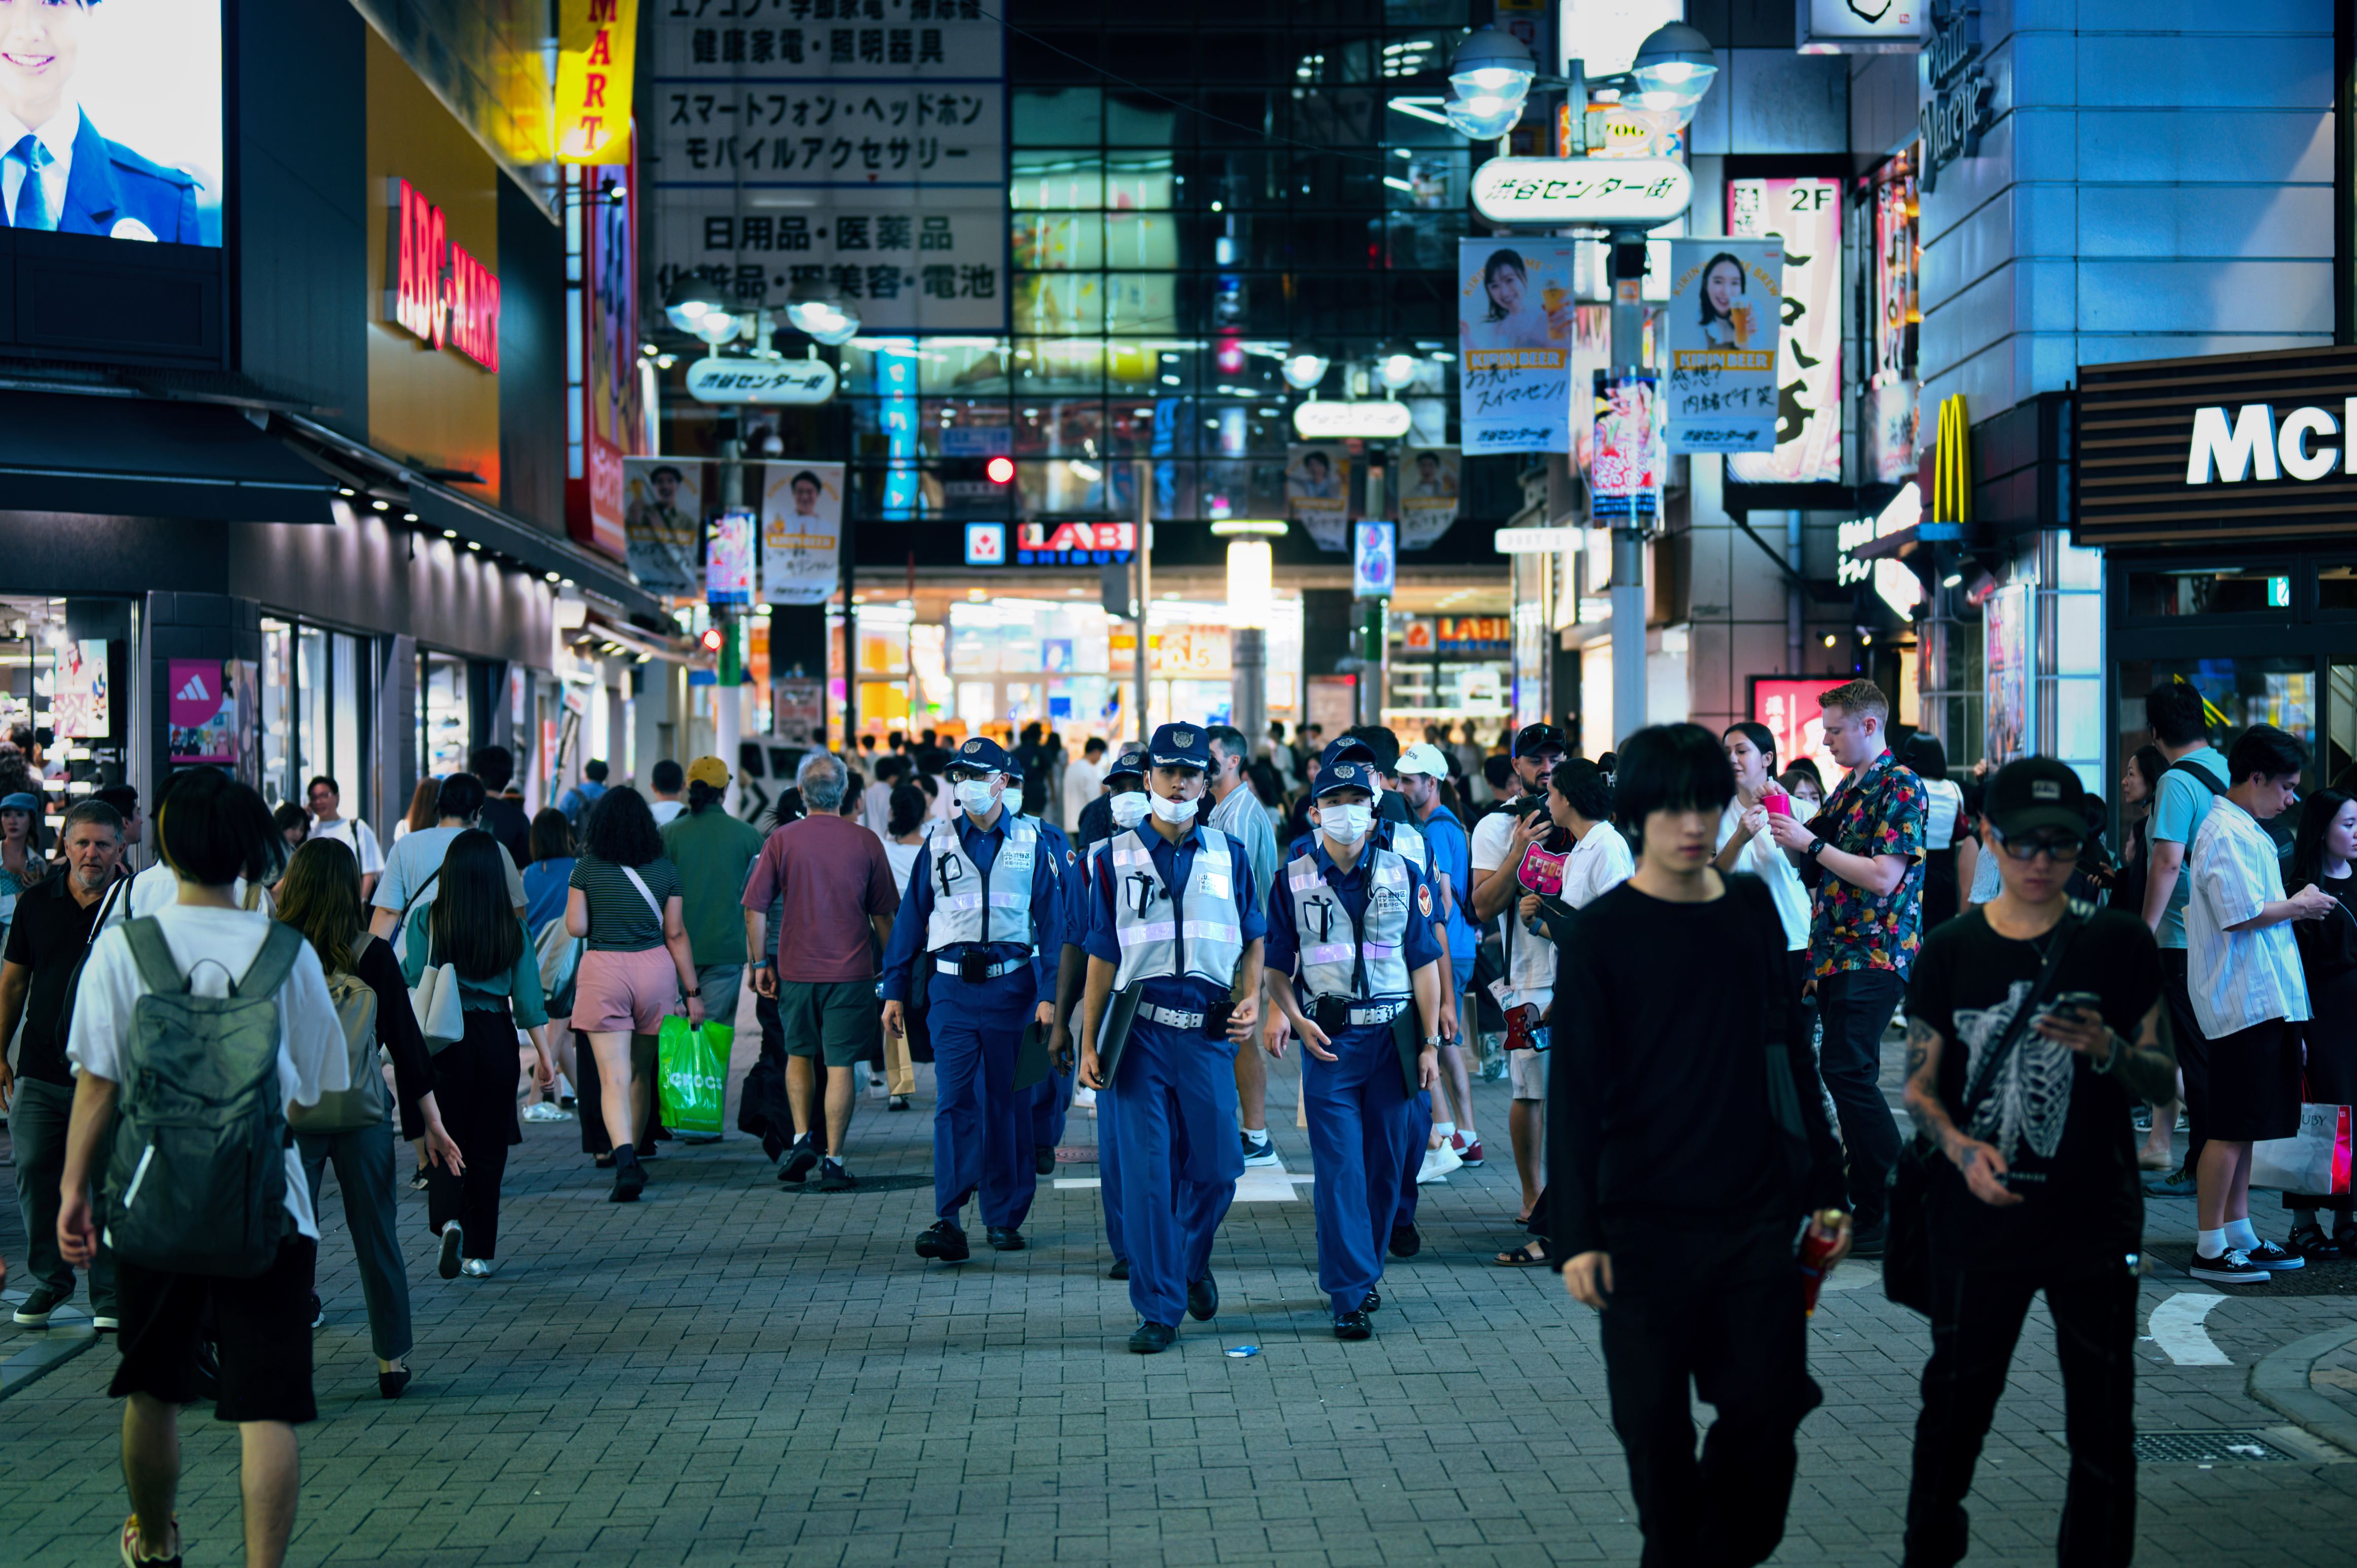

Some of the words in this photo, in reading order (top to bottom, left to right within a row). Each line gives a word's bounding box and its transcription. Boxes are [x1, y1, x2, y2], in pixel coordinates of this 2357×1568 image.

[580, 0, 617, 150] MART
[670, 93, 983, 126] スマートフォン・ヘッドホン
[686, 138, 968, 170] モバイルアクセサリー
[1486, 177, 1676, 200] 渋谷センター街
[1791, 189, 1832, 210] 2F
[705, 216, 953, 251] 日用品・医薬品
[1472, 353, 1517, 367] KIRIN
[1520, 352, 1559, 365] BEER
[1680, 353, 1724, 367] KIRIN
[1727, 353, 1768, 367] BEER
[697, 372, 828, 390] 渋谷センター街
[1017, 550, 1136, 565] SHIBUY
[669, 1073, 722, 1090] crocs
[2302, 1115, 2327, 1126] UBY
